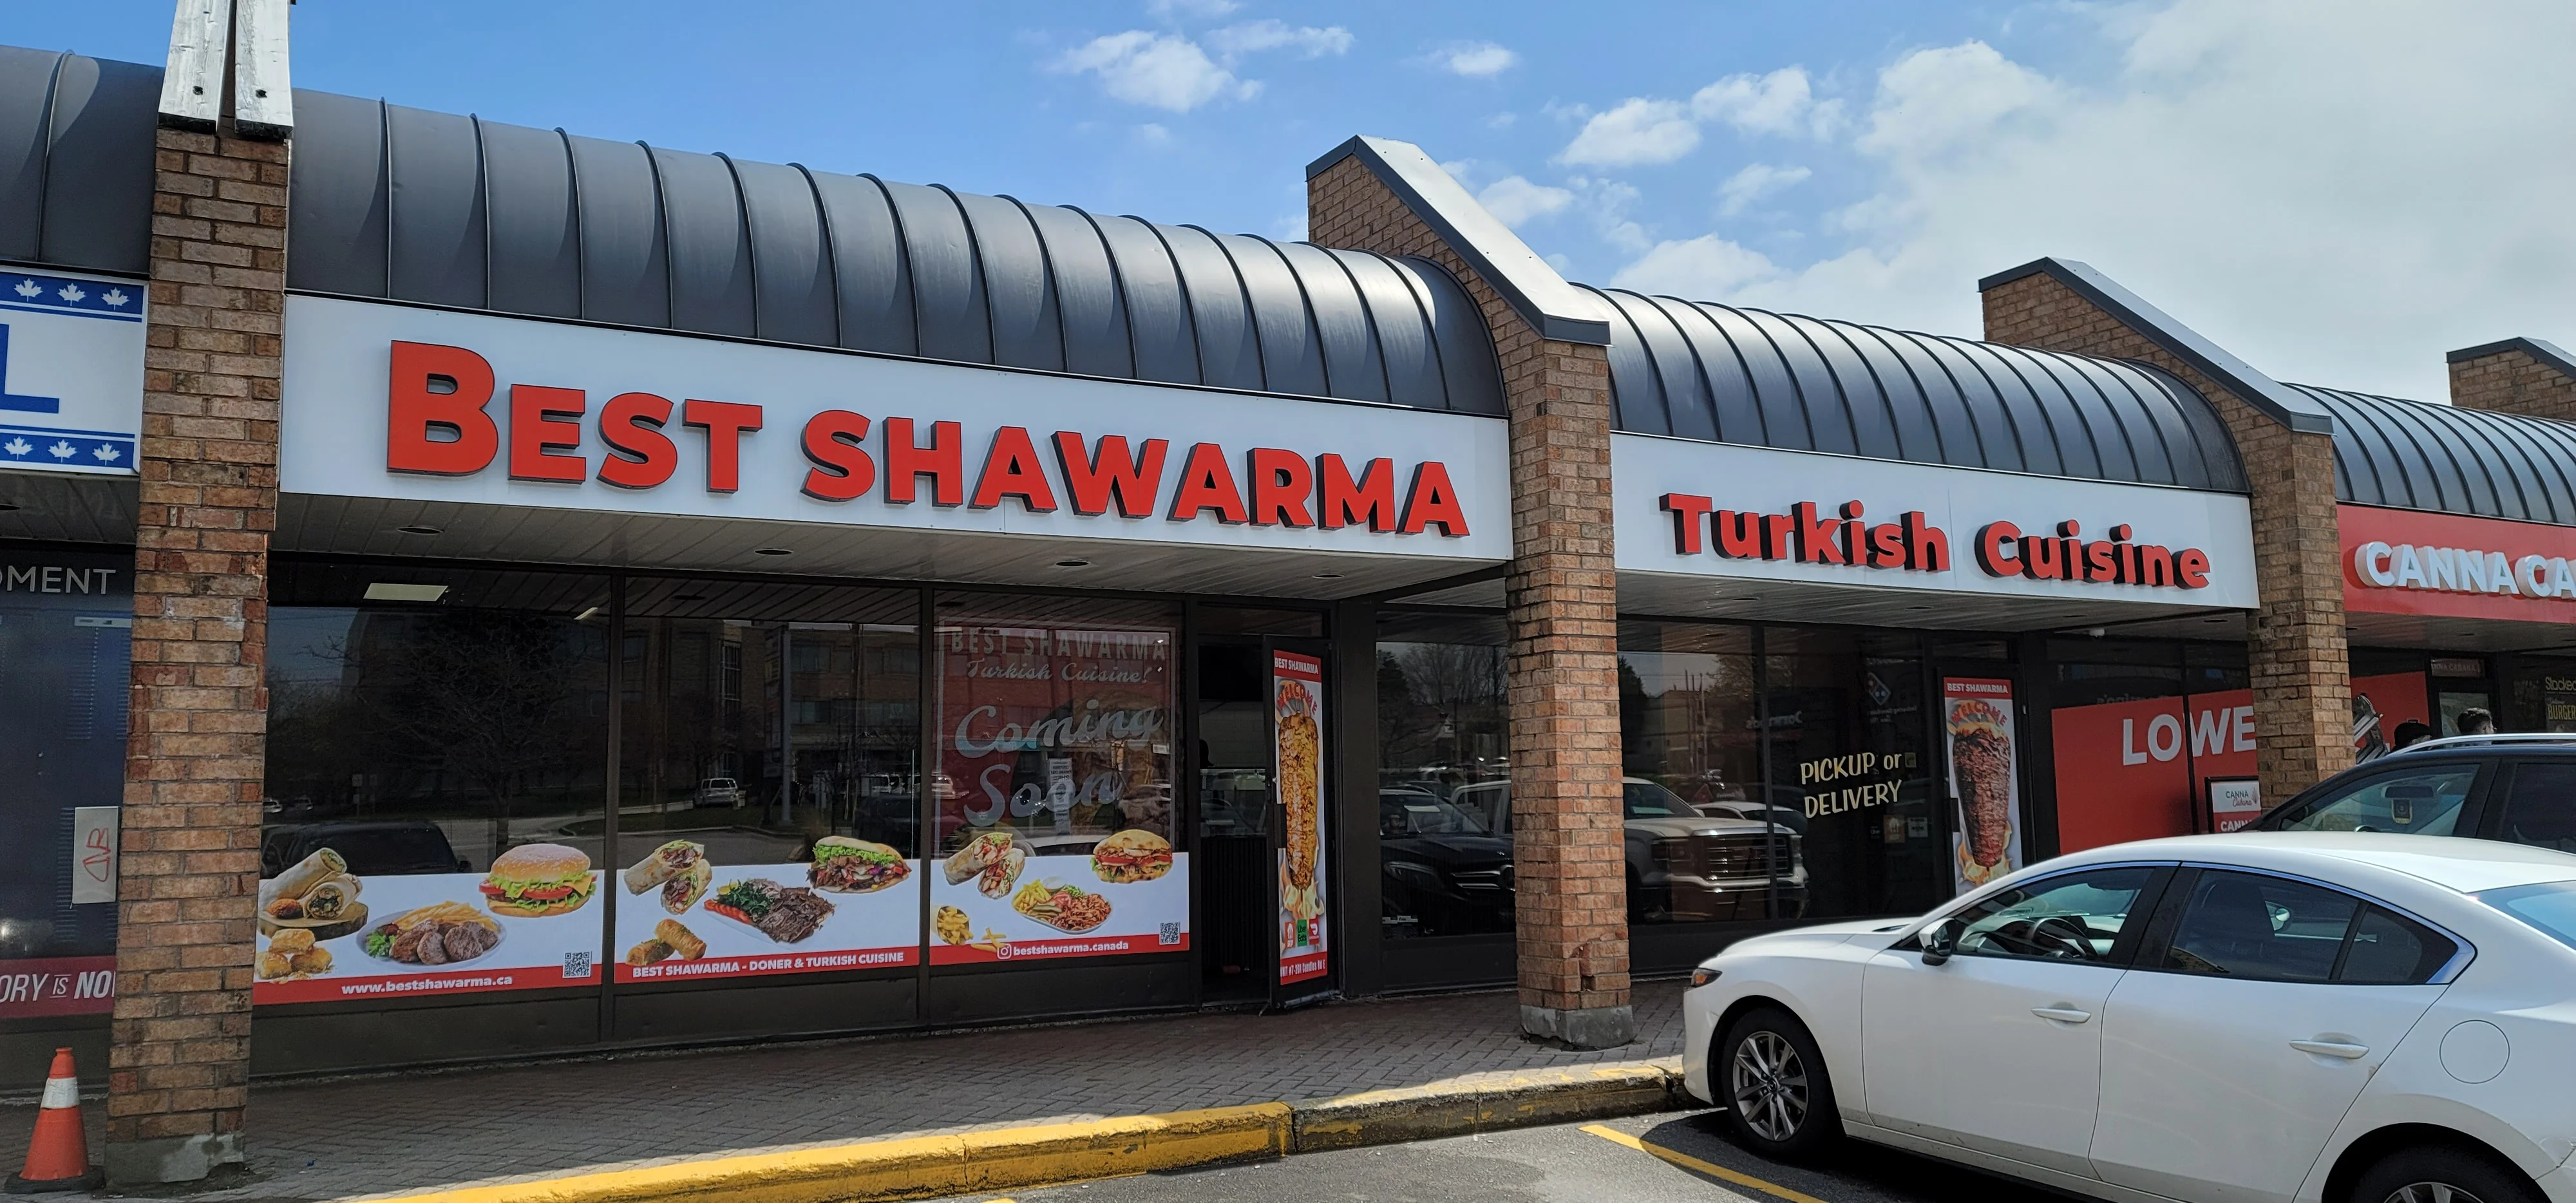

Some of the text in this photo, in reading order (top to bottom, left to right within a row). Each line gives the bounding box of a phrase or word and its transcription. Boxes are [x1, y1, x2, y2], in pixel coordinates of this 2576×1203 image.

[387, 340, 1471, 538] BEST SHAWARMA
[1660, 493, 2210, 589] Turkish Cuisine
[0, 565, 116, 594] MENT
[2354, 541, 2576, 599] CANNA CA
[951, 628, 1166, 661] BEST SHAWARMA
[967, 657, 1153, 684] Turkish Cuisine!
[1274, 658, 1319, 674] BEST SHAWARMA
[1277, 683, 1318, 715] WELCOME
[1947, 683, 2009, 694] BEST SHAWARMA
[1951, 701, 2008, 726] WELCOME
[954, 699, 1164, 759] Coming
[1800, 752, 1902, 785] PICKUP or
[963, 764, 1132, 828] Soon
[1804, 779, 1902, 819] DELIVERY
[2226, 790, 2249, 799] CANNA
[2220, 820, 2253, 832] CANN
[1013, 941, 1129, 956] bestshawarma.canada
[632, 967, 663, 978] BEST
[665, 962, 740, 976] SHAWARMA
[749, 958, 793, 971] DONER
[793, 958, 804, 969] &
[806, 955, 857, 967] TURKISH
[858, 952, 904, 965] CUISINE
[1323, 959, 1325, 969] E
[52, 976, 68, 995] IS
[74, 971, 116, 999] NO
[341, 976, 513, 995] www.bestshawarma.ca
